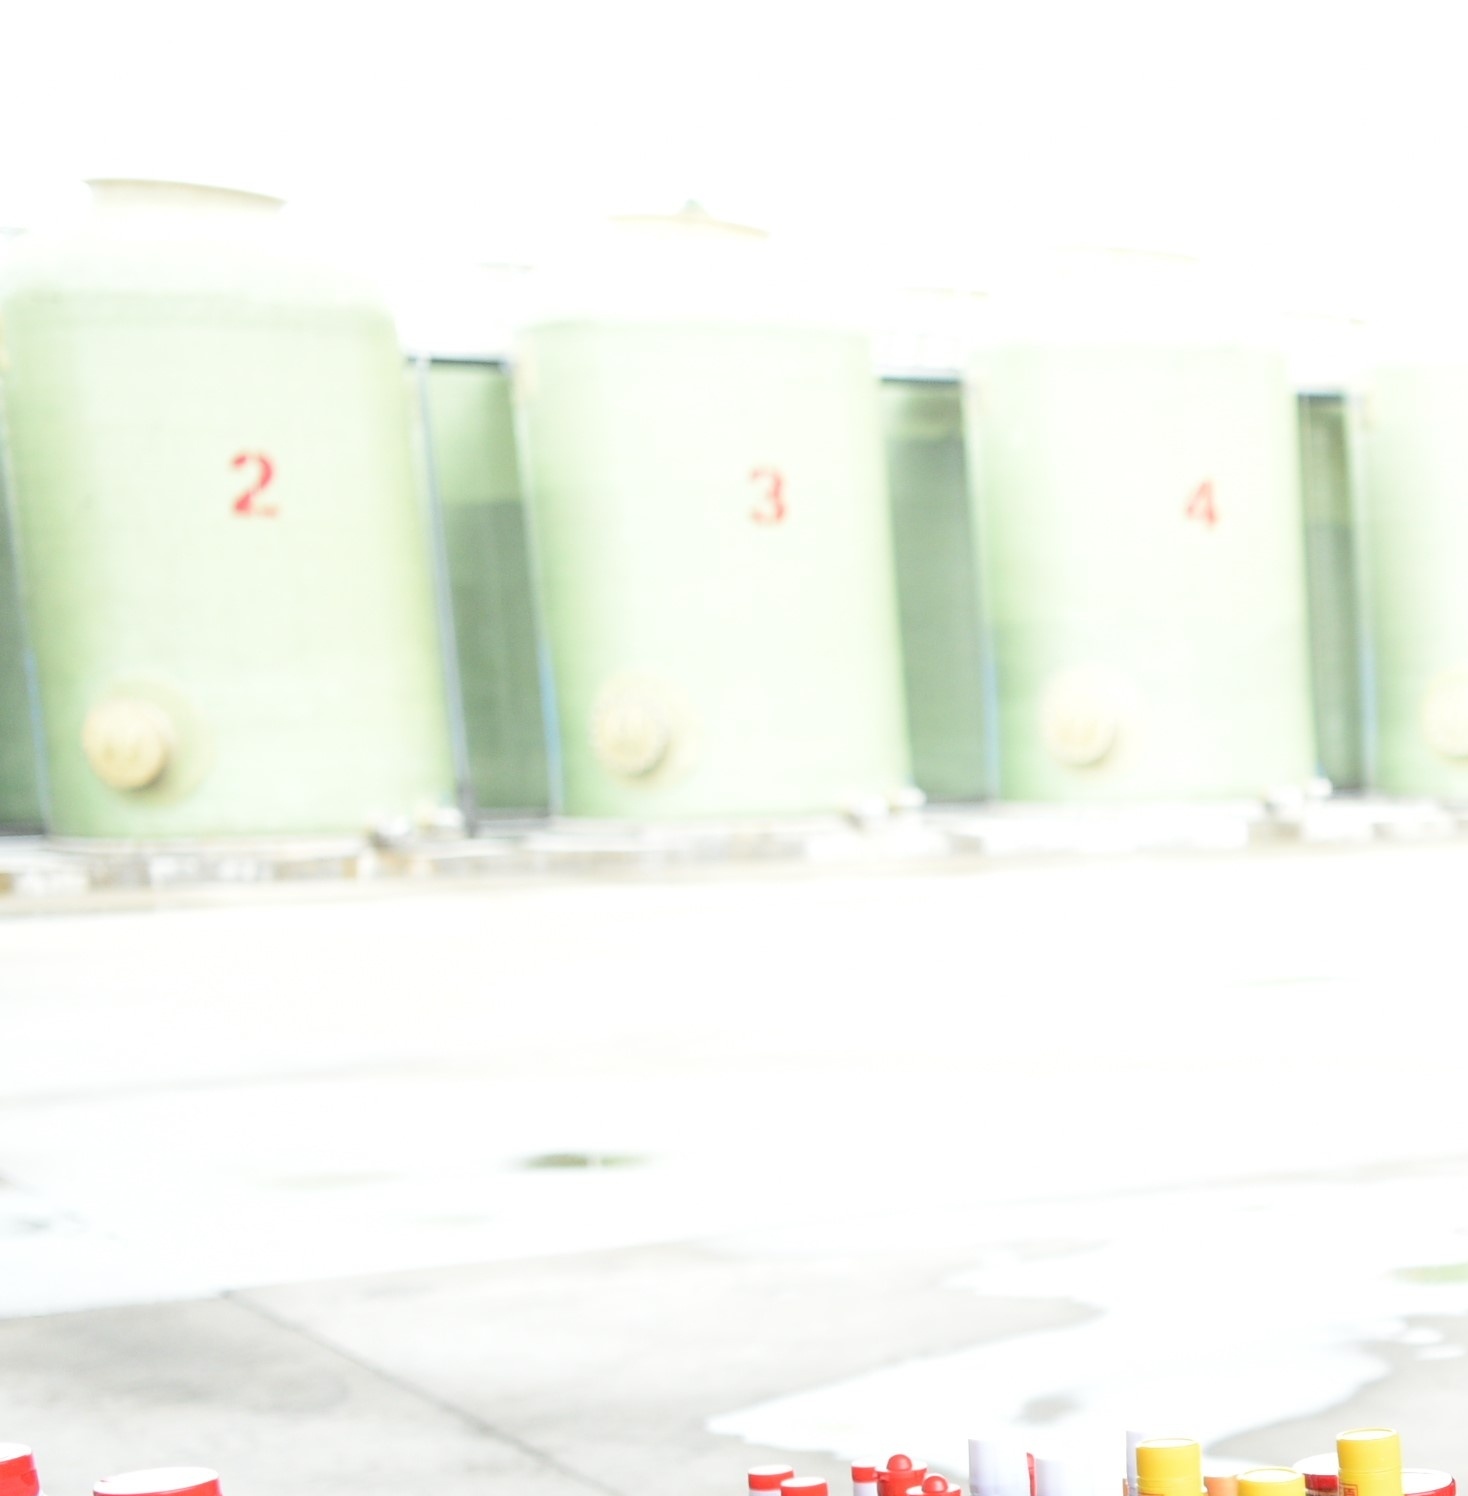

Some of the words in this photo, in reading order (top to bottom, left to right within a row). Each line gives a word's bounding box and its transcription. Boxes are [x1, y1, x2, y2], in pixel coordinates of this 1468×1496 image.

[230, 450, 280, 518] 2
[747, 466, 790, 526] 3
[1183, 476, 1220, 531] 4
